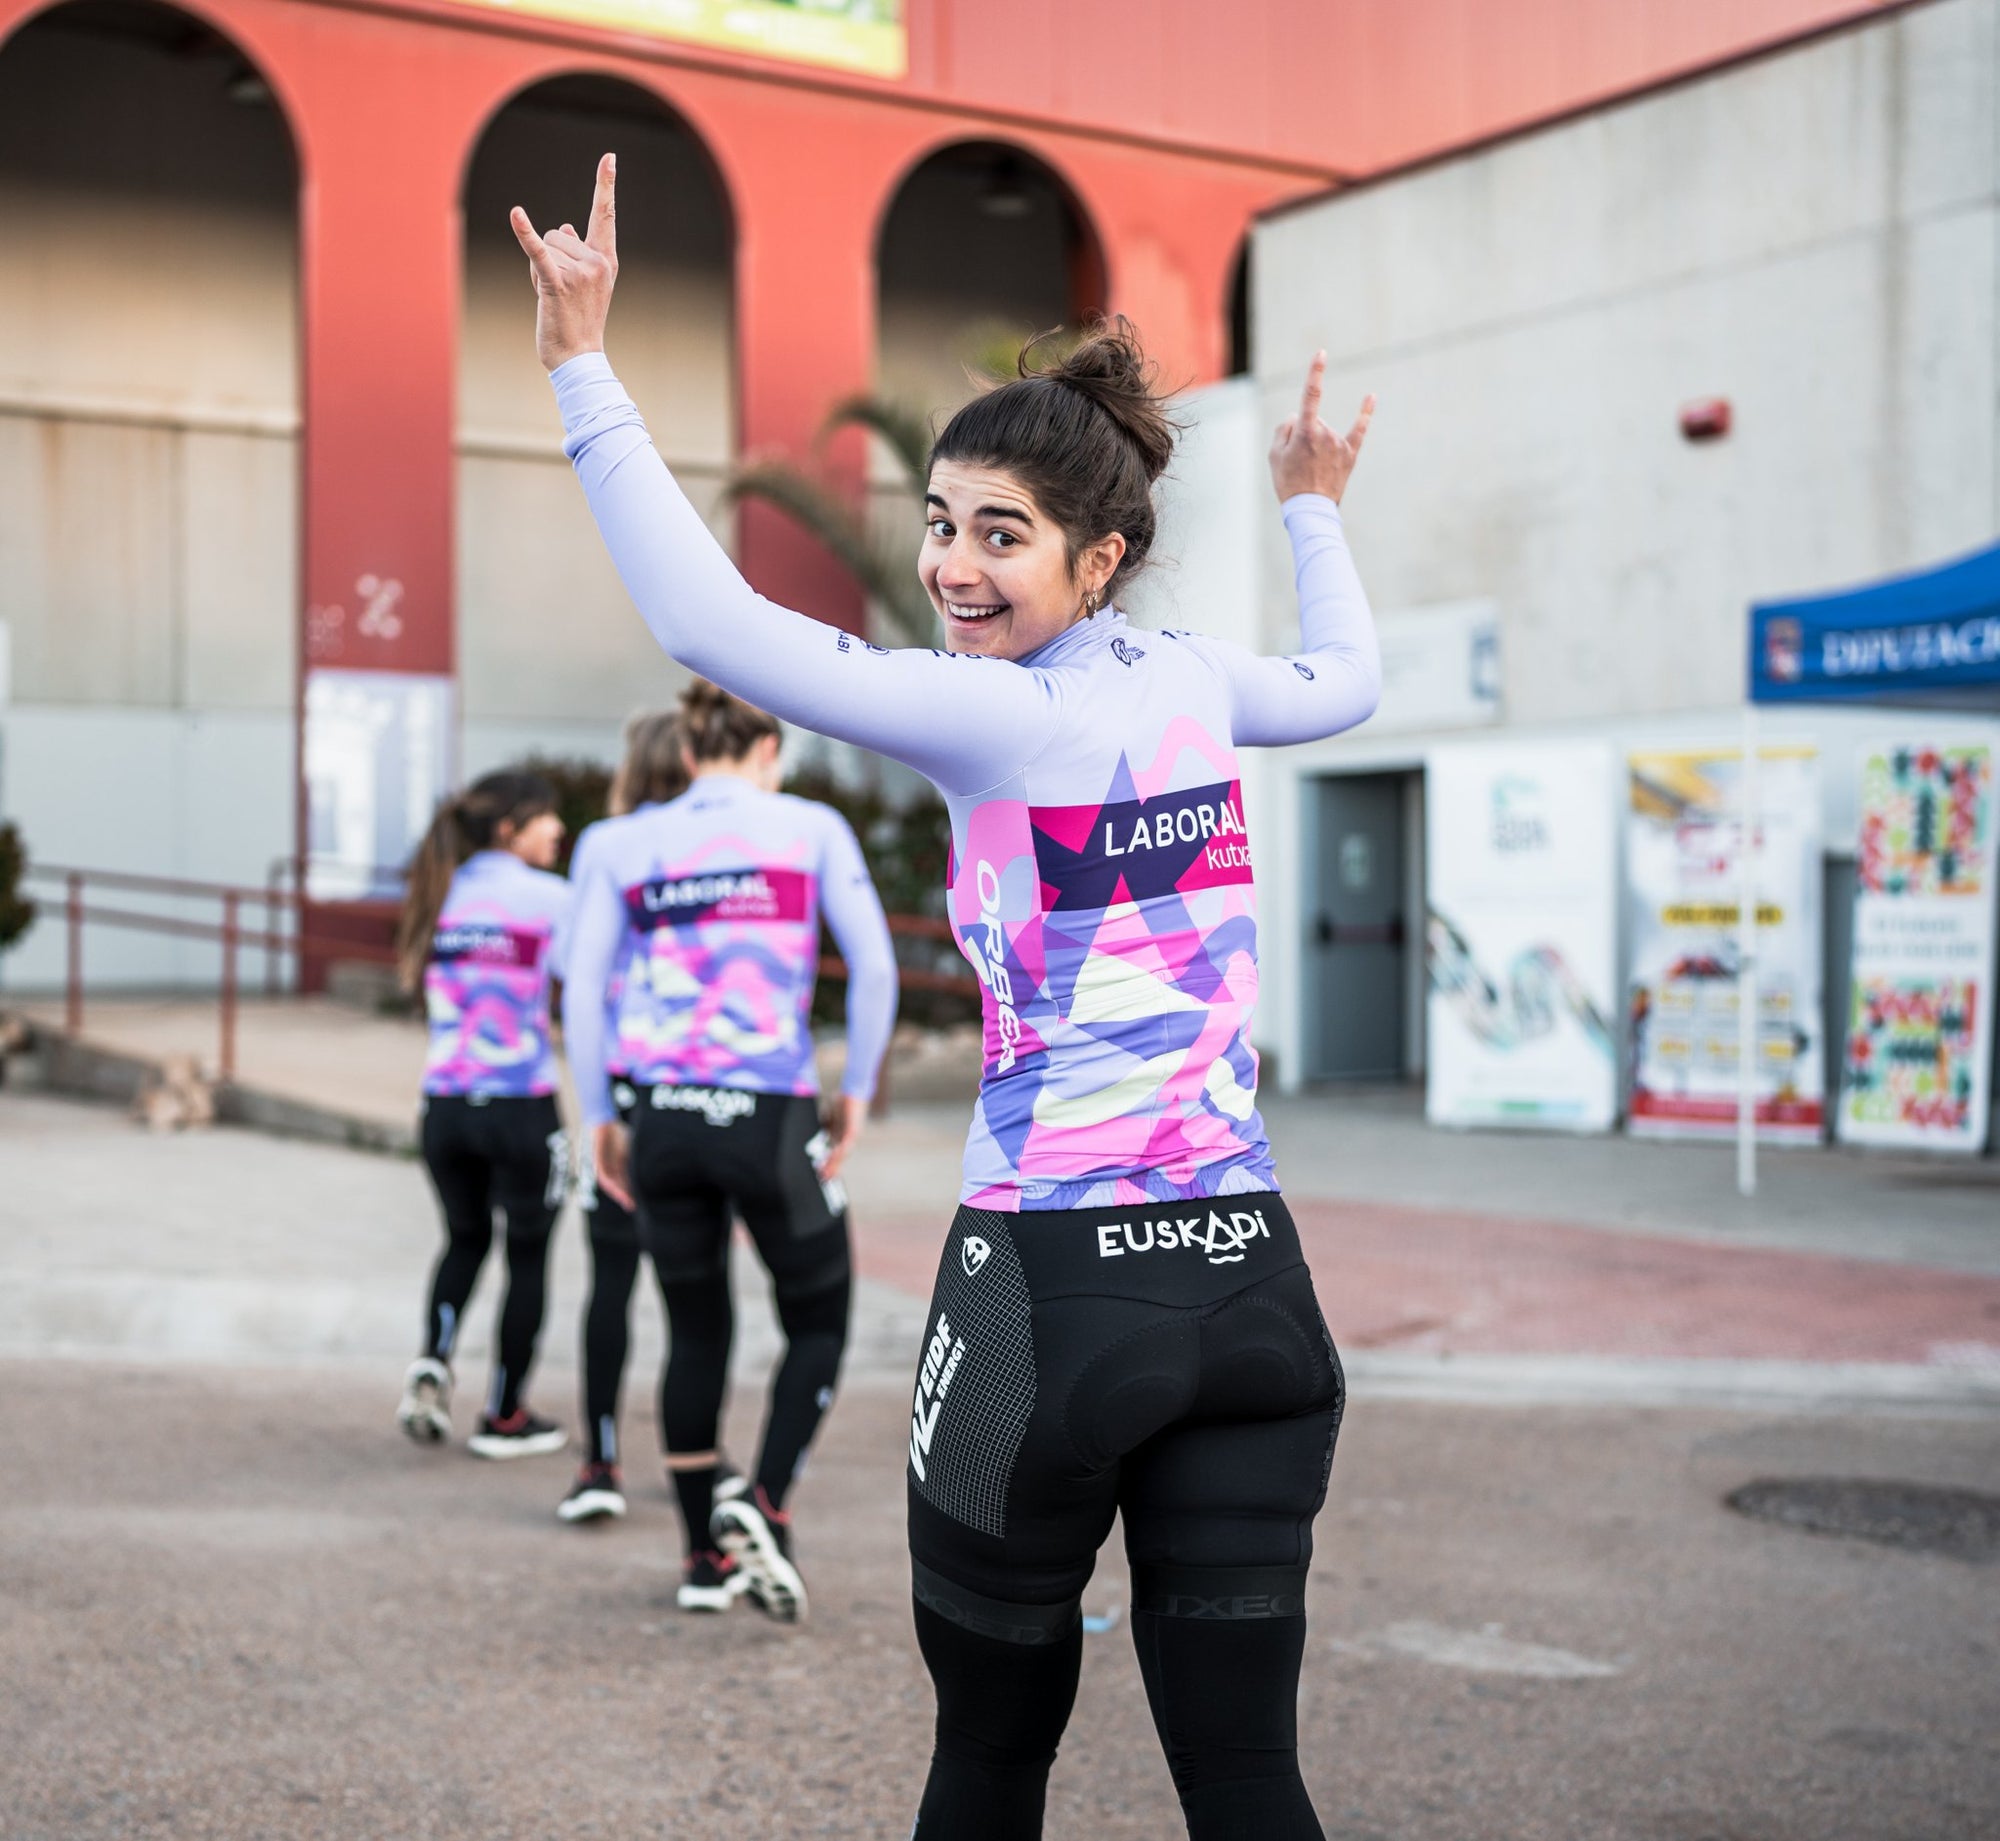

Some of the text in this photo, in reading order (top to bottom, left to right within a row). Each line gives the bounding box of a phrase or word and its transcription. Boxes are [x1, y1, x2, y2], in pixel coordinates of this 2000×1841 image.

[1105, 799, 1246, 856] LABORAL
[977, 859, 1022, 1074] ORBEA
[936, 1336, 967, 1399] ENERGY
